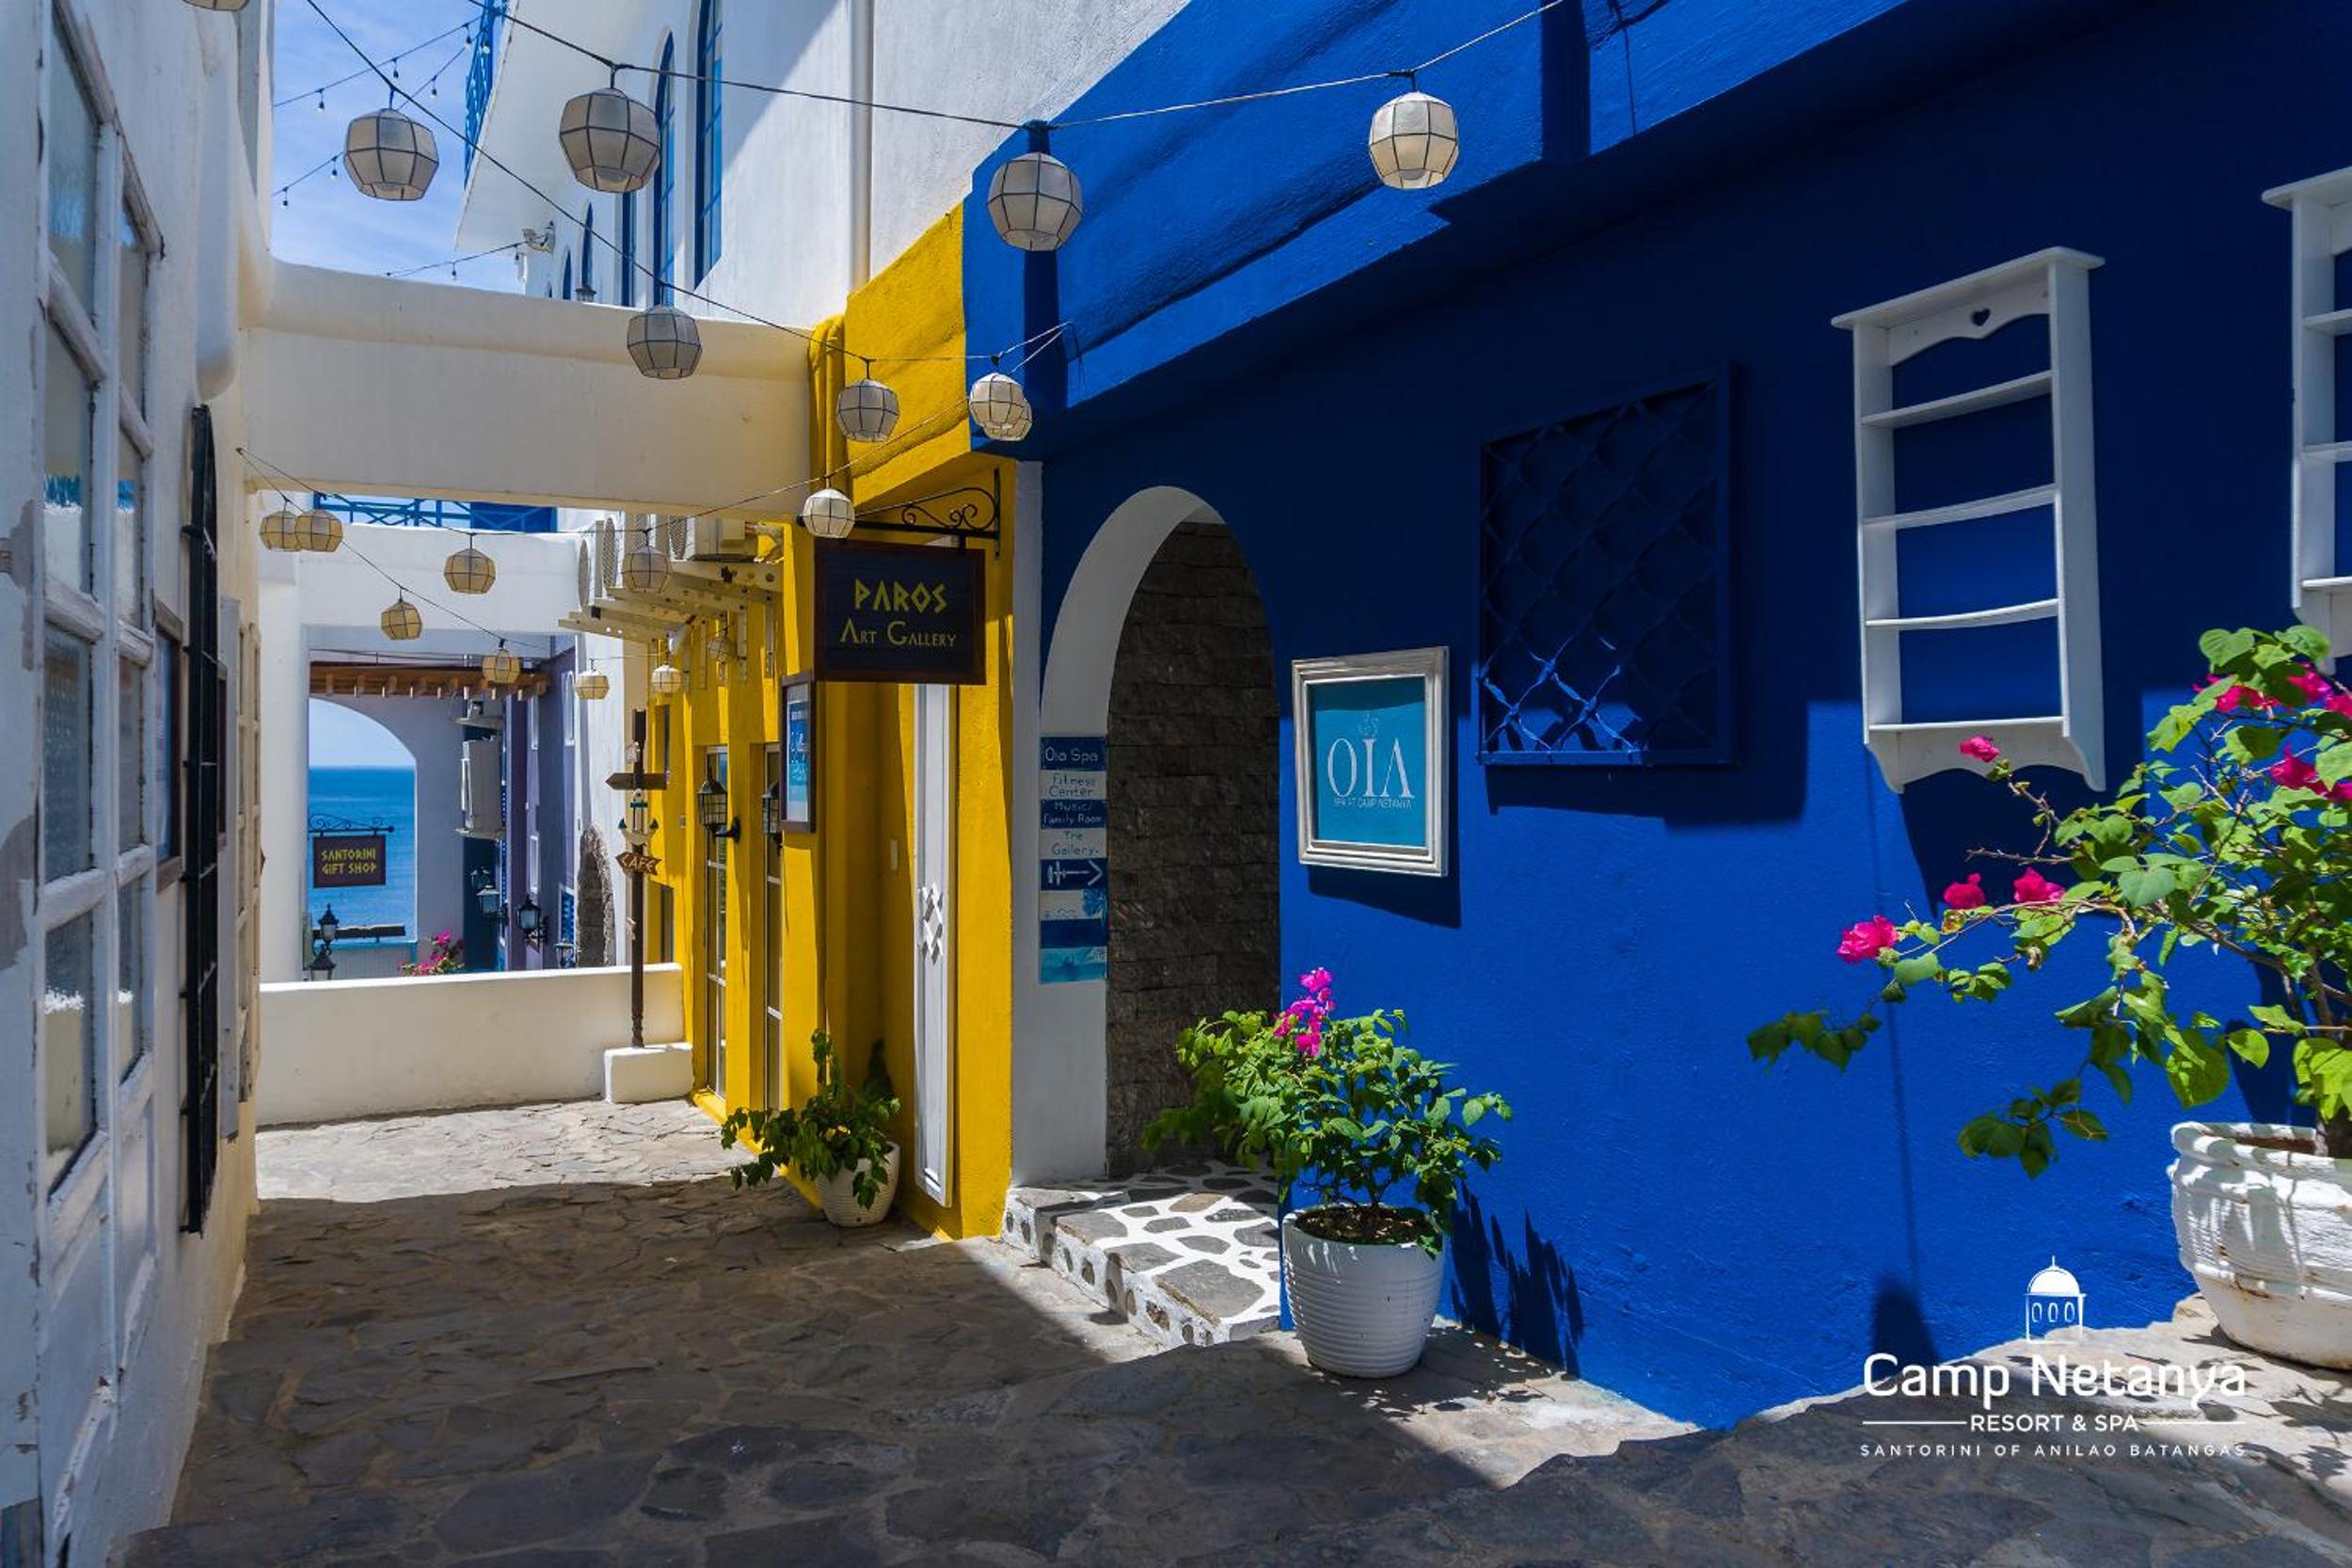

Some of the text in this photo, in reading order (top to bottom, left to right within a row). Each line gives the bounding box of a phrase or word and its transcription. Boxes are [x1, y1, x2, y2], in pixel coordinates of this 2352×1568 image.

[854, 578, 947, 613] PAROS
[1070, 747, 1099, 765] Spa
[321, 848, 376, 861] SANTORINI
[322, 862, 377, 875] GIFT SHOP
